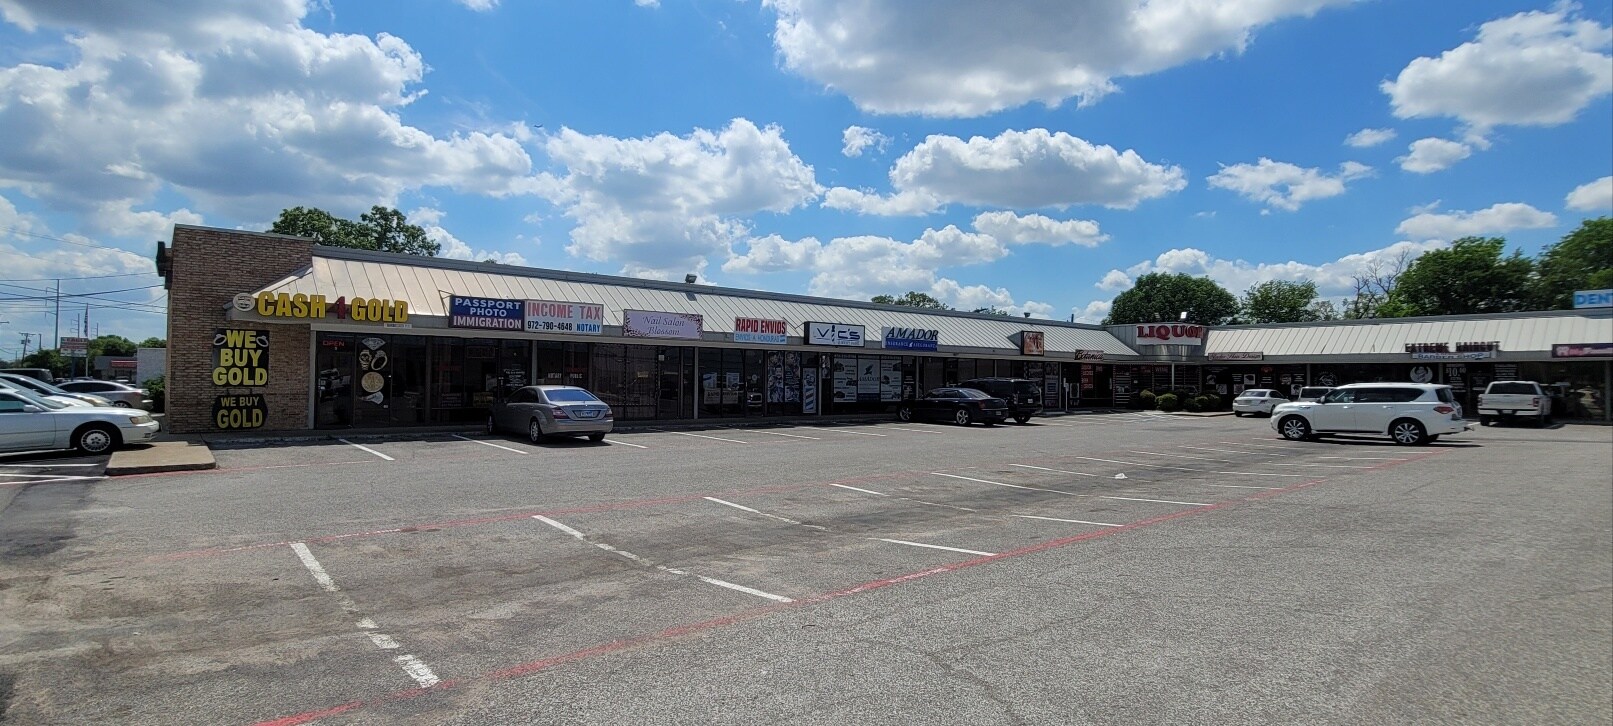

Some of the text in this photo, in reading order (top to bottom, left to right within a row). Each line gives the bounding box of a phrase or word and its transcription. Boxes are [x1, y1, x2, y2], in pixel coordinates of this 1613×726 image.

[257, 291, 409, 323] CASH 4 GOLD
[454, 298, 521, 310] PASSPORT
[527, 301, 601, 320] INCOME TAX
[469, 307, 508, 317] PHOTO
[453, 315, 522, 329] IMMIGRATION
[527, 320, 601, 333] 972-790-4648 NOTARY
[642, 316, 685, 327] Nail Salon
[735, 319, 786, 335] RAPID ENVIOS
[647, 325, 680, 336] Blossom
[885, 326, 939, 341] AMADOR
[226, 329, 257, 348] WE
[322, 340, 345, 348] OPEN
[220, 349, 262, 367] BUY
[212, 366, 268, 386] GOLD
[221, 396, 260, 407] WE BUY
[216, 408, 263, 429] GOLD
